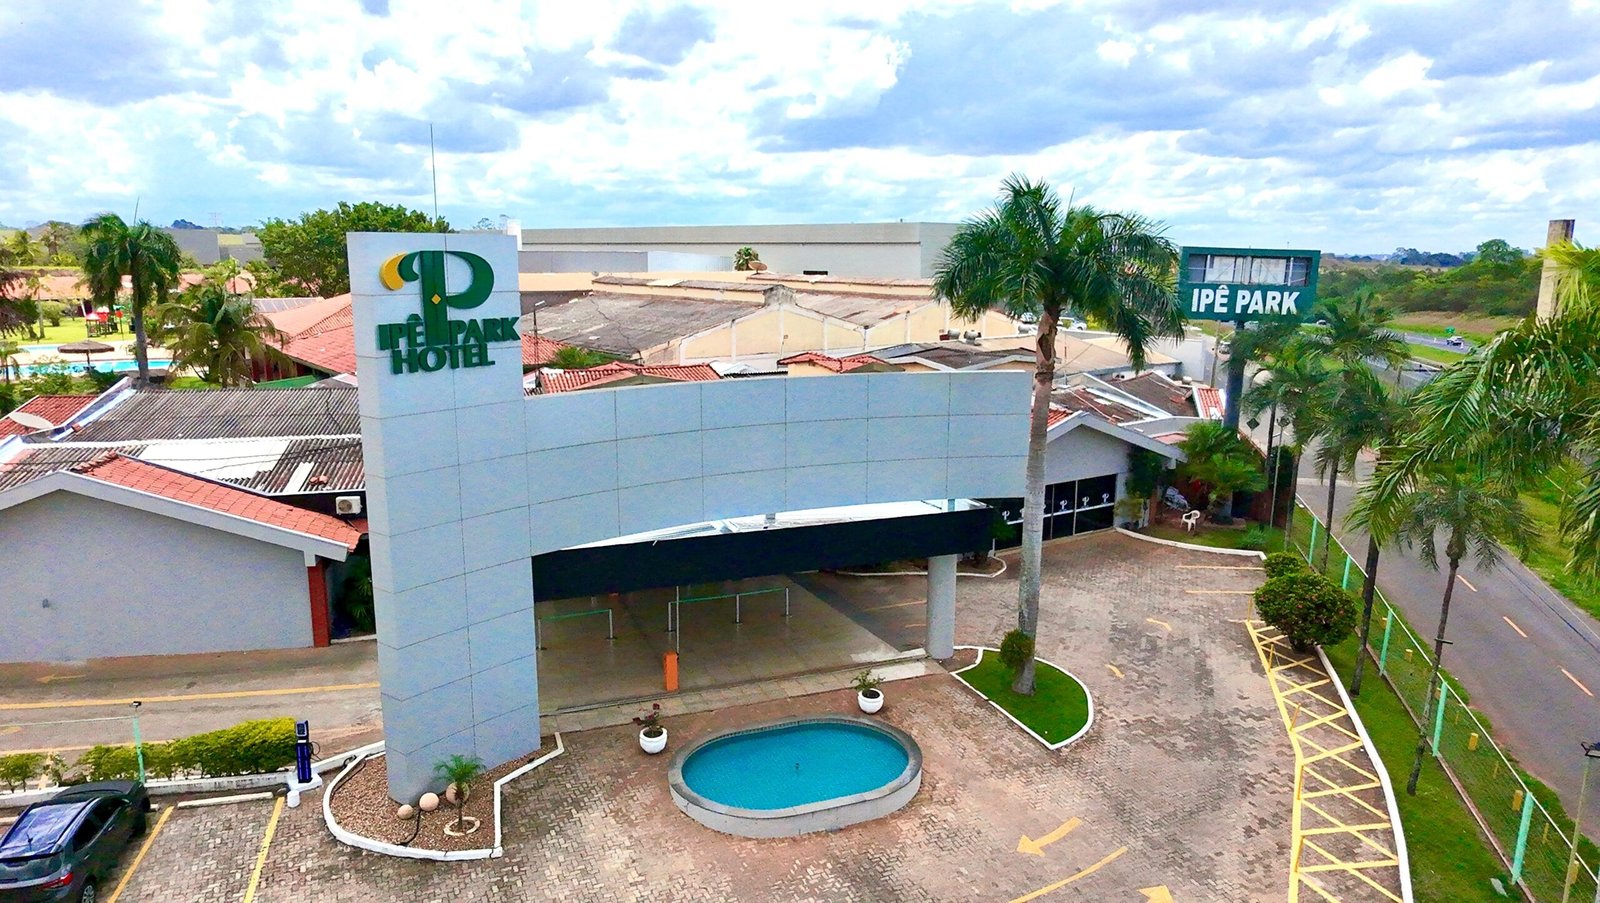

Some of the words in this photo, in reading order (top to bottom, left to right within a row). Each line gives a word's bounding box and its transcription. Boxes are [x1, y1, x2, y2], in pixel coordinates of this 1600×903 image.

[1191, 285, 1229, 313] IPÊ
[1235, 290, 1300, 315] PARK
[378, 313, 425, 350] IPÊ
[449, 316, 521, 345] PARK
[391, 343, 495, 374] HOTEL
